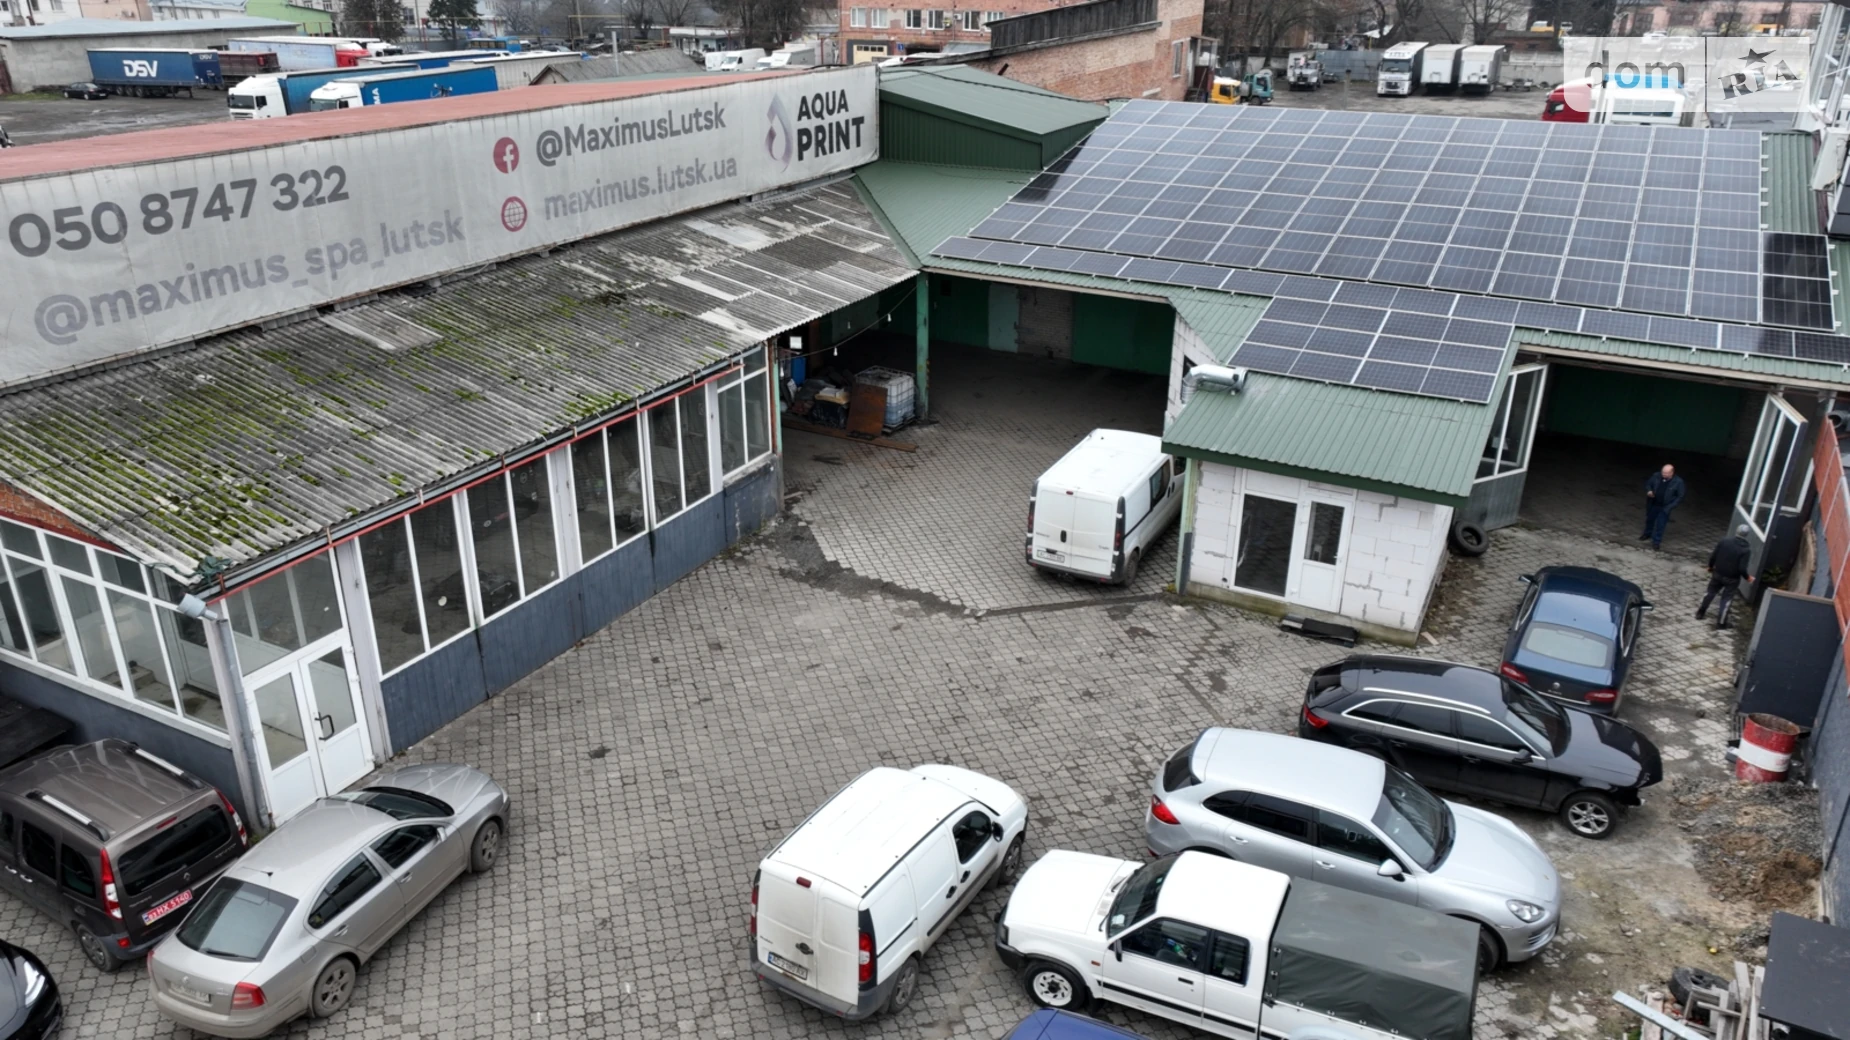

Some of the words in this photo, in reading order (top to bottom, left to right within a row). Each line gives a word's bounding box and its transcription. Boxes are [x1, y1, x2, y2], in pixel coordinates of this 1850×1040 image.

[123, 59, 158, 77] DSV
[536, 101, 726, 167] @MaximusLutsk
[797, 89, 849, 121] AQUA
[797, 116, 864, 161] PRINT
[9, 201, 128, 257] 050
[139, 178, 257, 235] 8747
[270, 165, 349, 211] 322
[544, 157, 737, 220] maximus.lutsk.ua
[34, 209, 466, 345] @maximus_spa_lutsk
